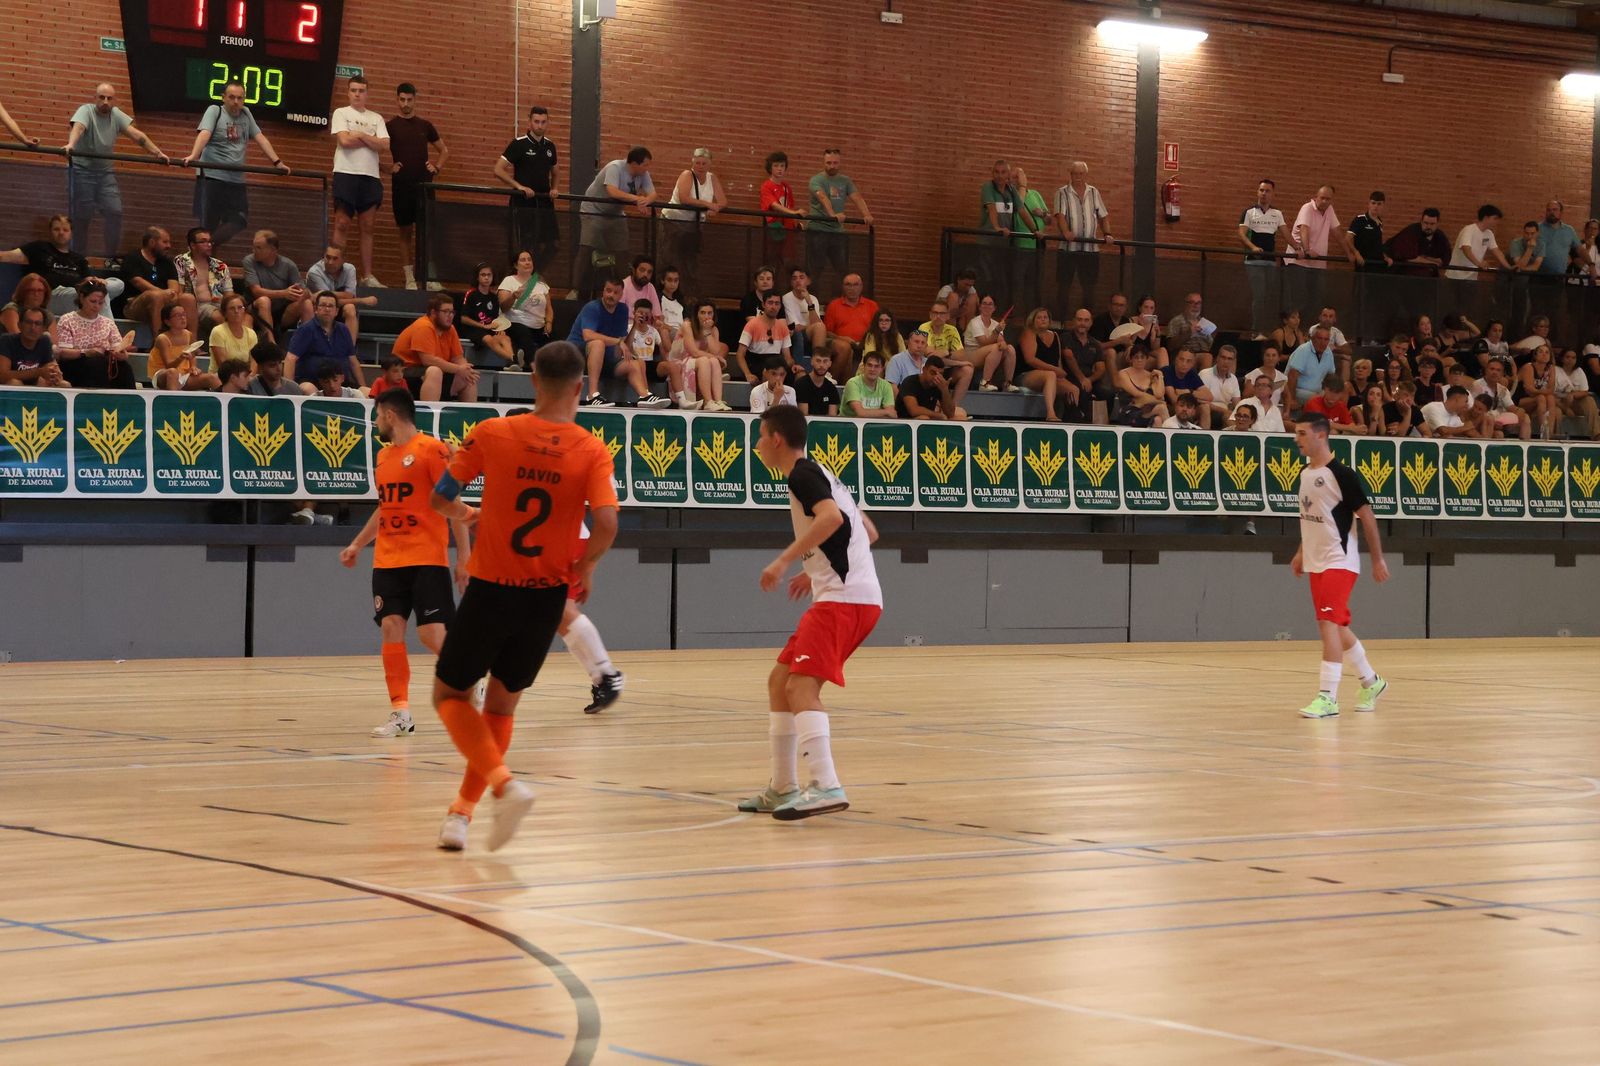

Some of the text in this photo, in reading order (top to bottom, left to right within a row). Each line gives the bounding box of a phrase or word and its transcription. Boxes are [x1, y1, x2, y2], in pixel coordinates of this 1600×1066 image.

[237, 1, 244, 29] 1
[298, 4, 317, 43] 2
[220, 35, 254, 48] PERIODO
[293, 113, 328, 126] MONDO
[0, 468, 65, 478] CAJA RURAL
[78, 468, 144, 479] CAJA RURAL
[156, 469, 221, 479] CAJA RURAL
[233, 470, 295, 480] CAJA RURAL
[306, 471, 366, 481] CAJA RURAL
[516, 466, 561, 484] DAVID
[634, 480, 686, 490] CAJA RURAL
[695, 482, 744, 491] CAJA RURAL
[753, 483, 773, 492] CAJA
[866, 486, 912, 494] CAJA RURAL
[920, 487, 965, 495] CAJA RURAL
[973, 488, 1017, 496] CAJA RURAL
[1025, 489, 1068, 497] CAJA RURAL
[1076, 490, 1118, 498] CAJA RURAL
[1126, 491, 1167, 499] CAJA RURAL
[1174, 492, 1216, 500] CAJA RURAL
[1222, 493, 1262, 501] CAJA RURAL
[1268, 494, 1285, 502] CAJA
[1375, 496, 1396, 504] RURAL
[1402, 497, 1439, 505] CAJA RURAL
[1445, 498, 1482, 506] CAJA RURAL
[1503, 499, 1524, 507] RURAL
[1571, 500, 1586, 508] CAJA
[511, 487, 553, 557] 2
